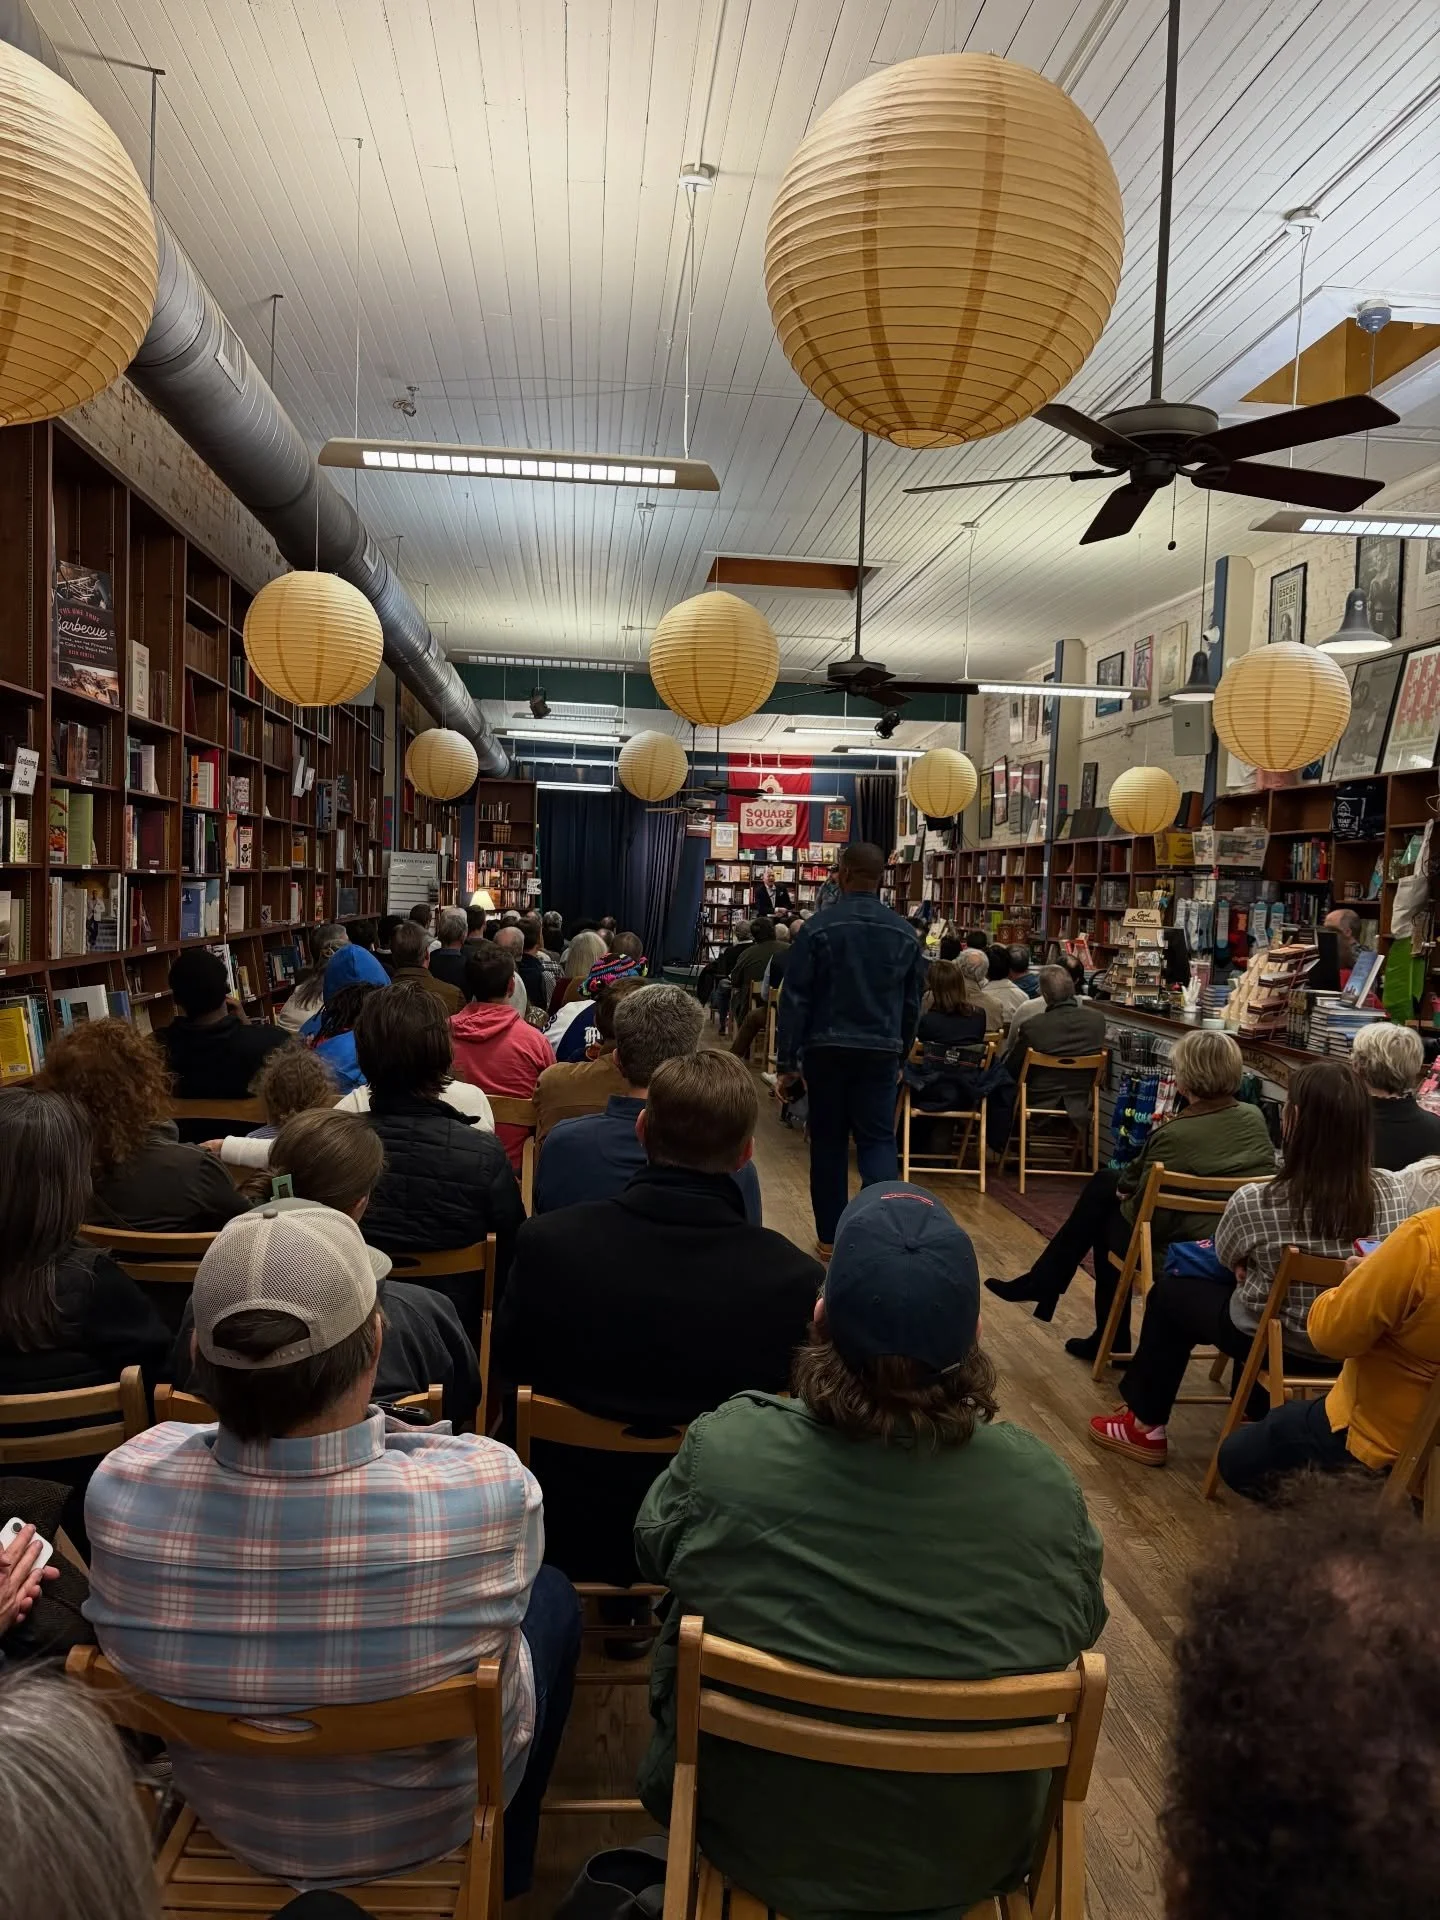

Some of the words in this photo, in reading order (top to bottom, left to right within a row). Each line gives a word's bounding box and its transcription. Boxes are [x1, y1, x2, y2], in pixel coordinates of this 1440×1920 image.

[1279, 584, 1296, 598] OSCAR
[1279, 593, 1296, 607] WILDE
[745, 808, 793, 818] SQUARE
[746, 818, 793, 828] BOOKS
